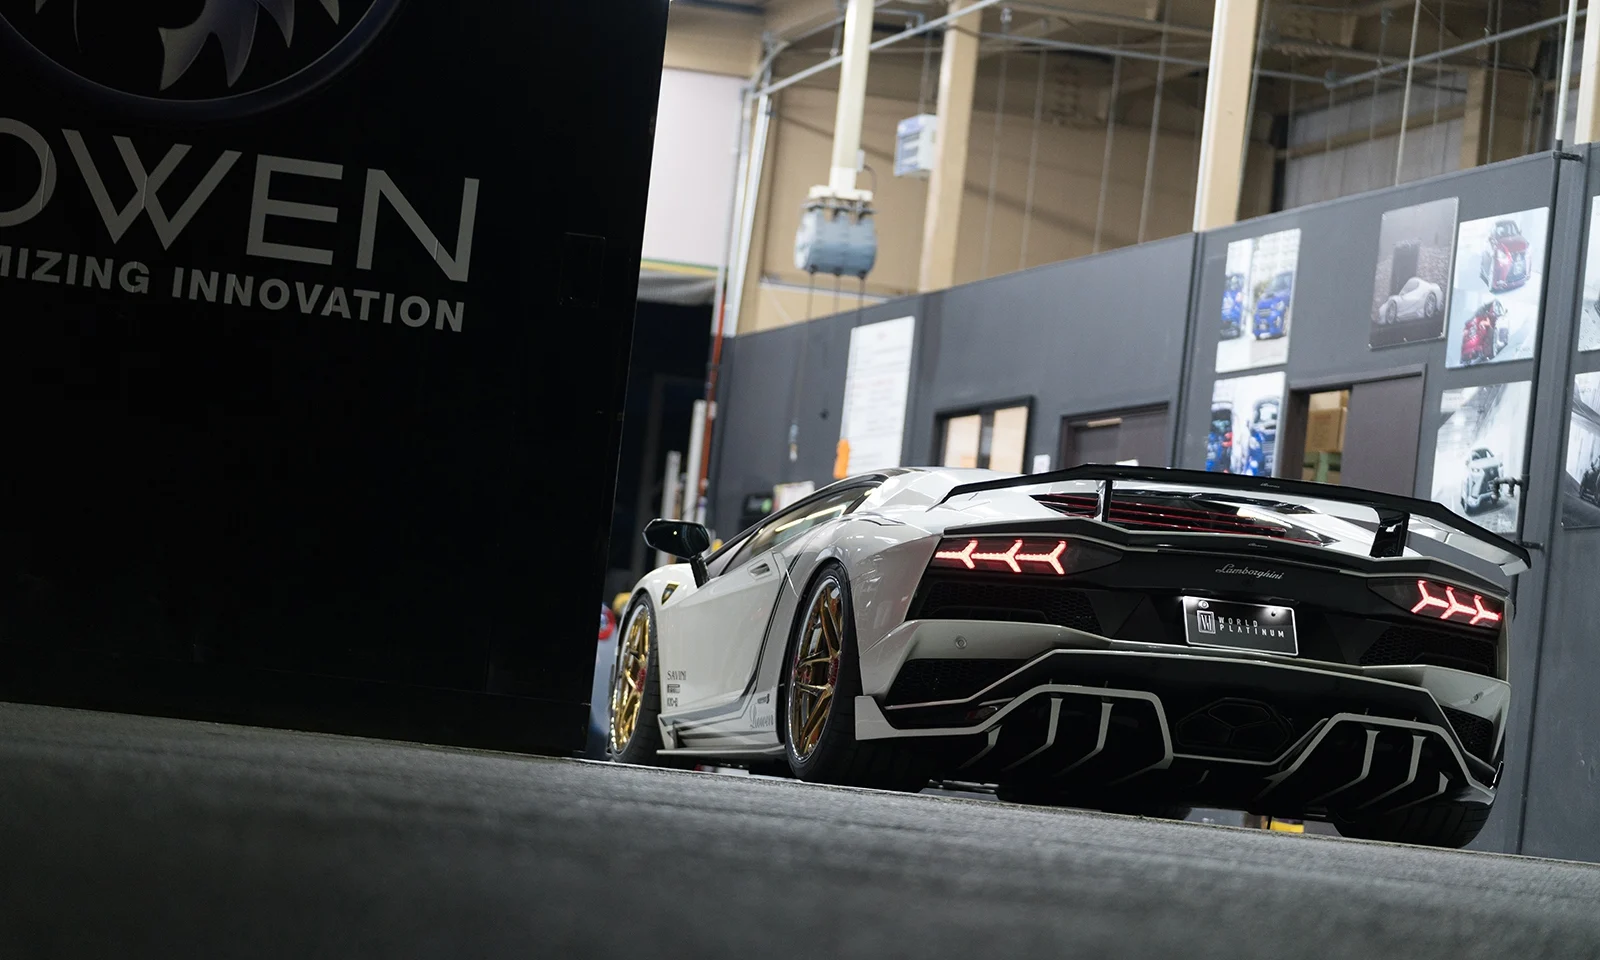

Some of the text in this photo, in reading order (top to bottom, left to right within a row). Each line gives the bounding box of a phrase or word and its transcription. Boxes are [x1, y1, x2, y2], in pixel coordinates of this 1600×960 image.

[172, 267, 464, 332] INNOVATION
[1215, 564, 1284, 579] Lamborghini
[1218, 616, 1258, 628] WORLD
[1219, 624, 1284, 638] PLATINUM
